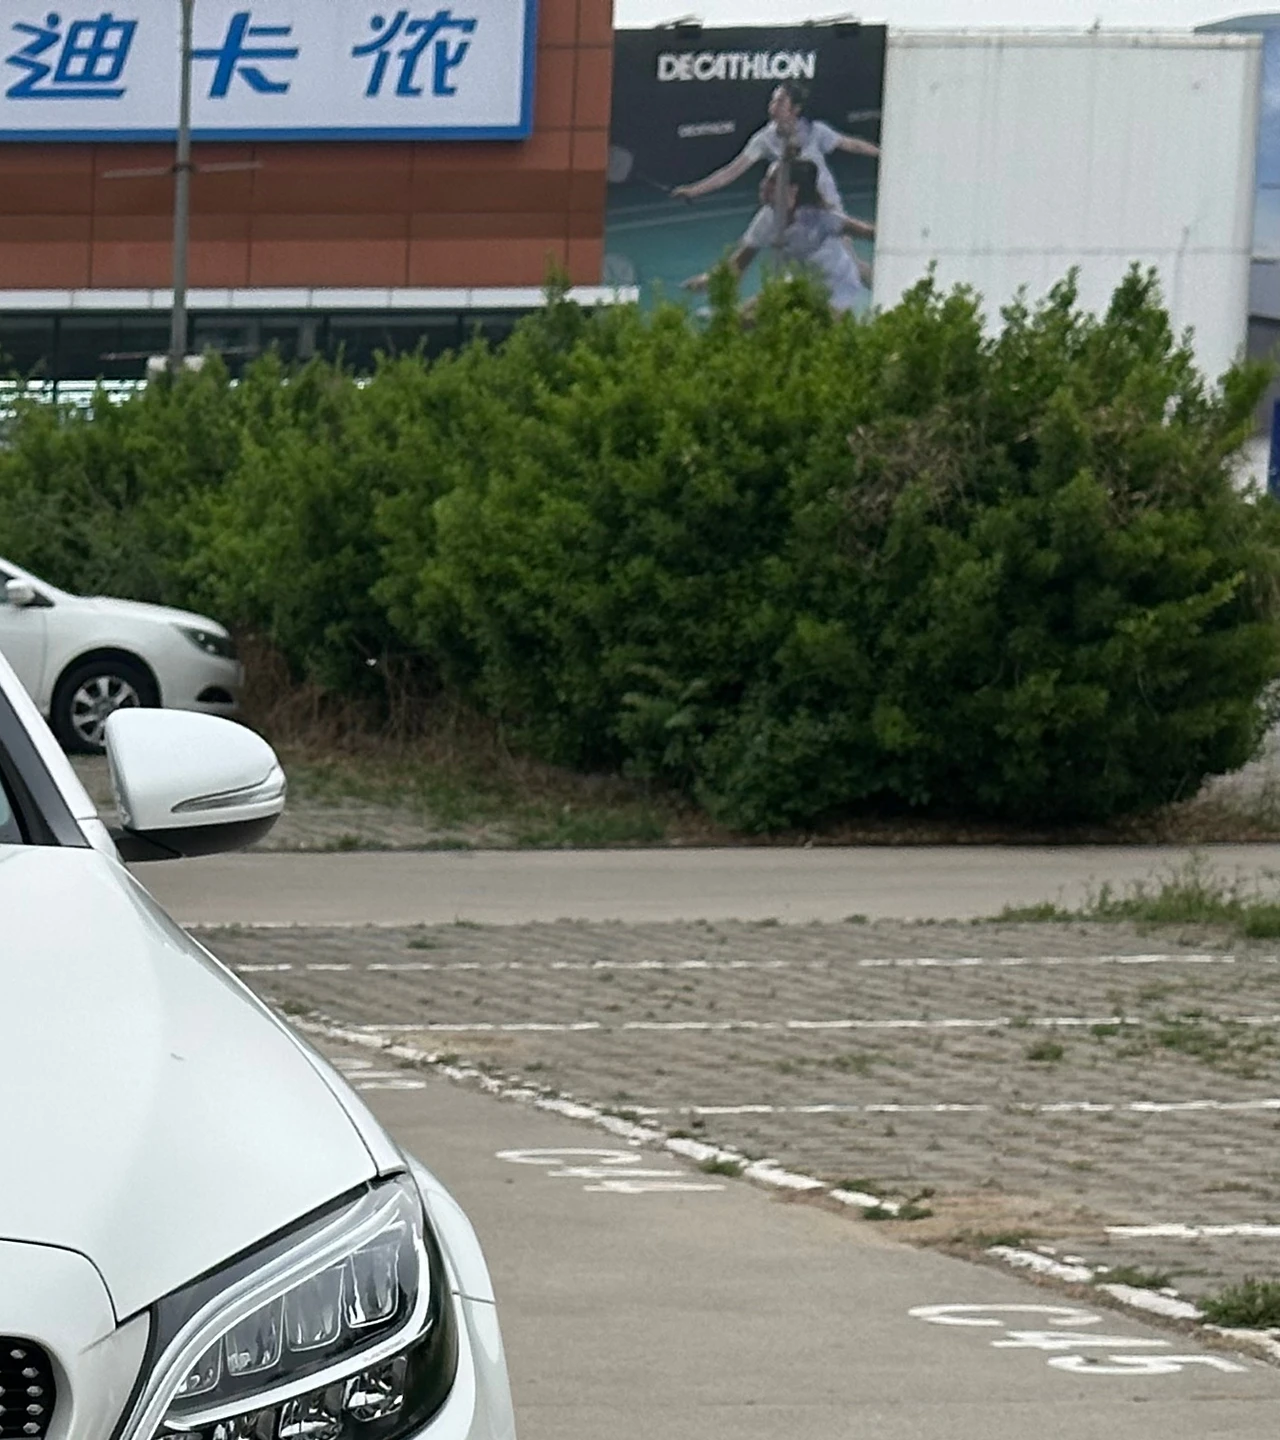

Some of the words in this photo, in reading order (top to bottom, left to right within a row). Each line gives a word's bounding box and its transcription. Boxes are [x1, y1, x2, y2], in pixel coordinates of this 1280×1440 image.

[4, 9, 478, 98] 迪卡侬
[657, 52, 816, 81] DECATHLON
[907, 1302, 1249, 1374] C45
